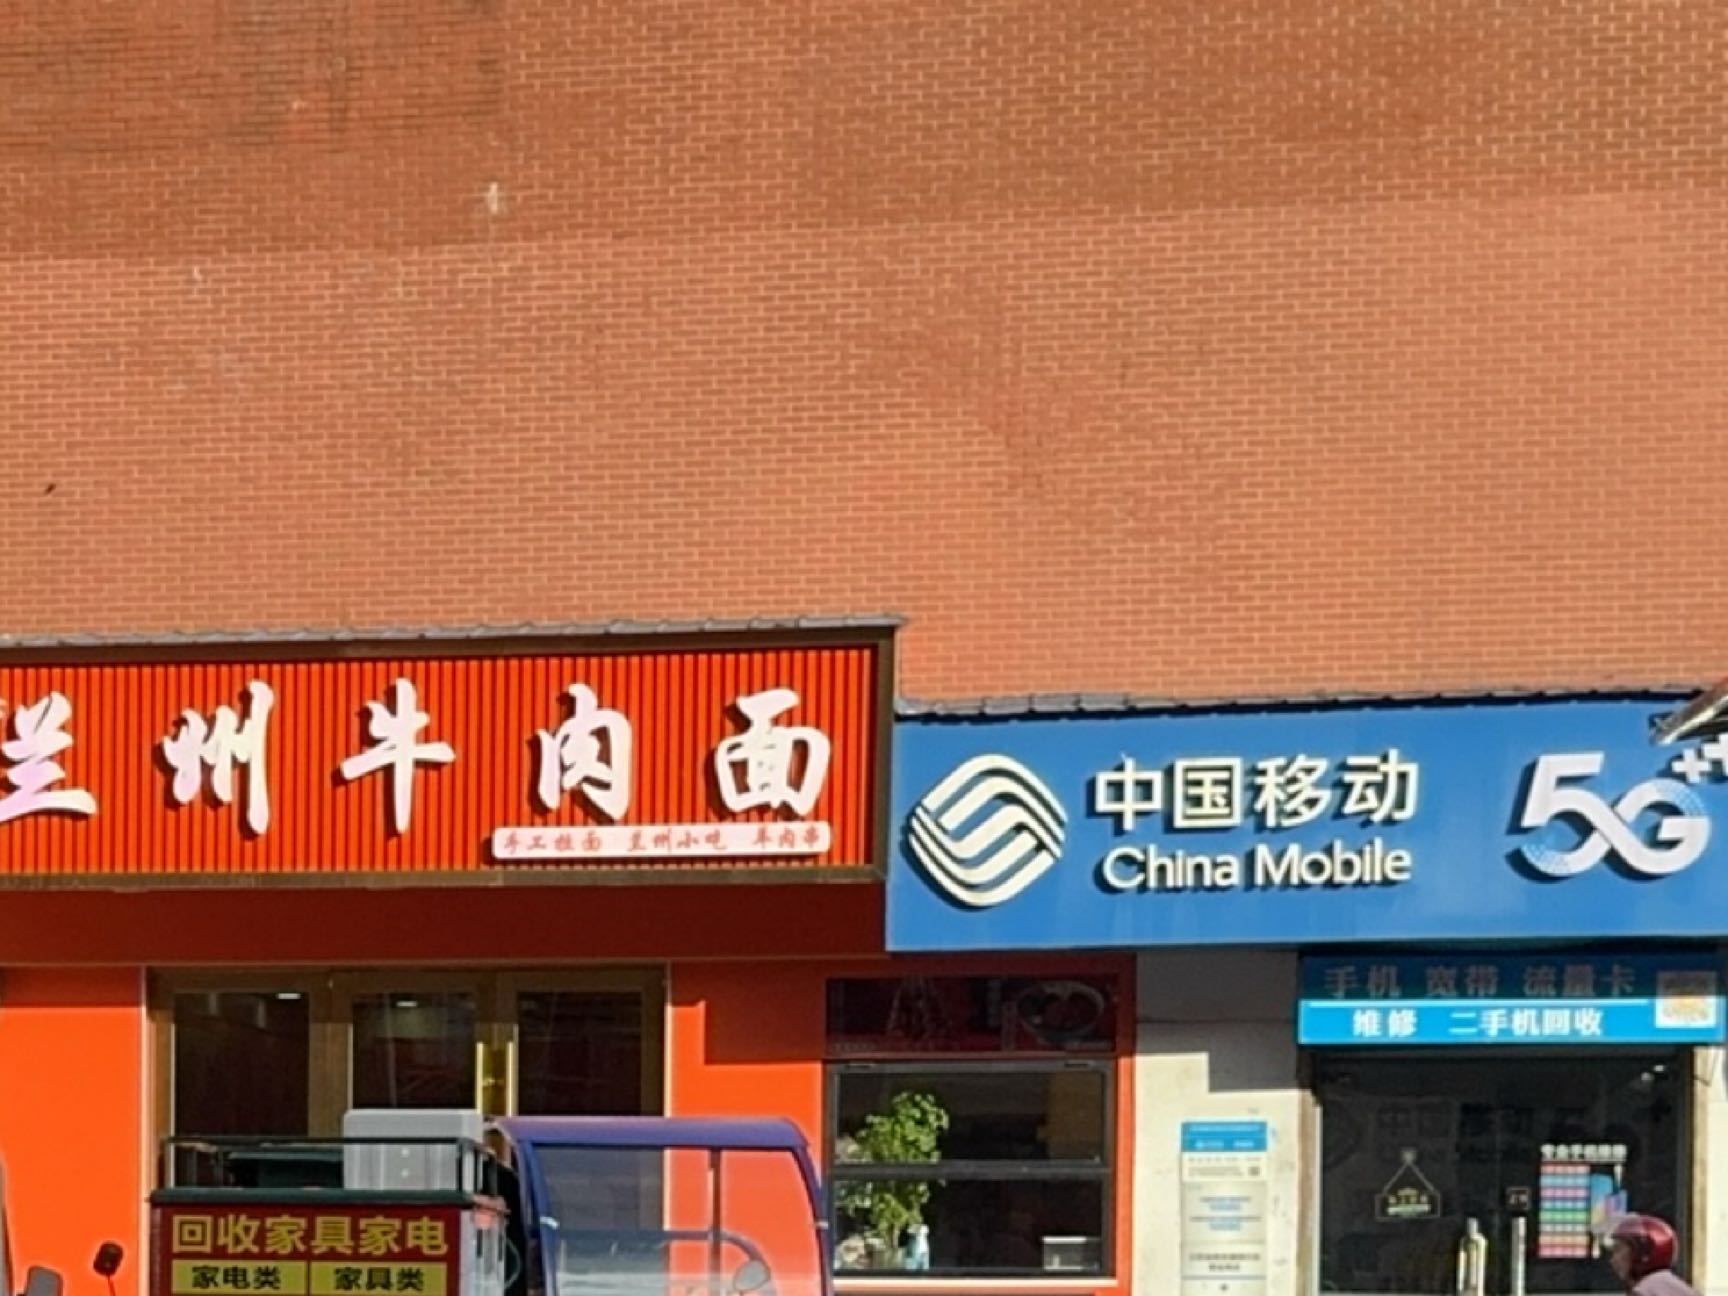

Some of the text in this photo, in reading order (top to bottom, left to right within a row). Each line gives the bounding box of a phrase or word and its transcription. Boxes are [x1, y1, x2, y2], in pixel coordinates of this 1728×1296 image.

[1095, 750, 1419, 831] 中国移动
[1103, 837, 1412, 889] China Mobile
[1325, 963, 1636, 998] 手机 宽带 流量卡
[1353, 1007, 1603, 1037] 维修 二手机回收
[172, 1214, 448, 1255] 回收家具家电
[192, 1266, 281, 1290] 家电类
[335, 1267, 424, 1291] 家具类
